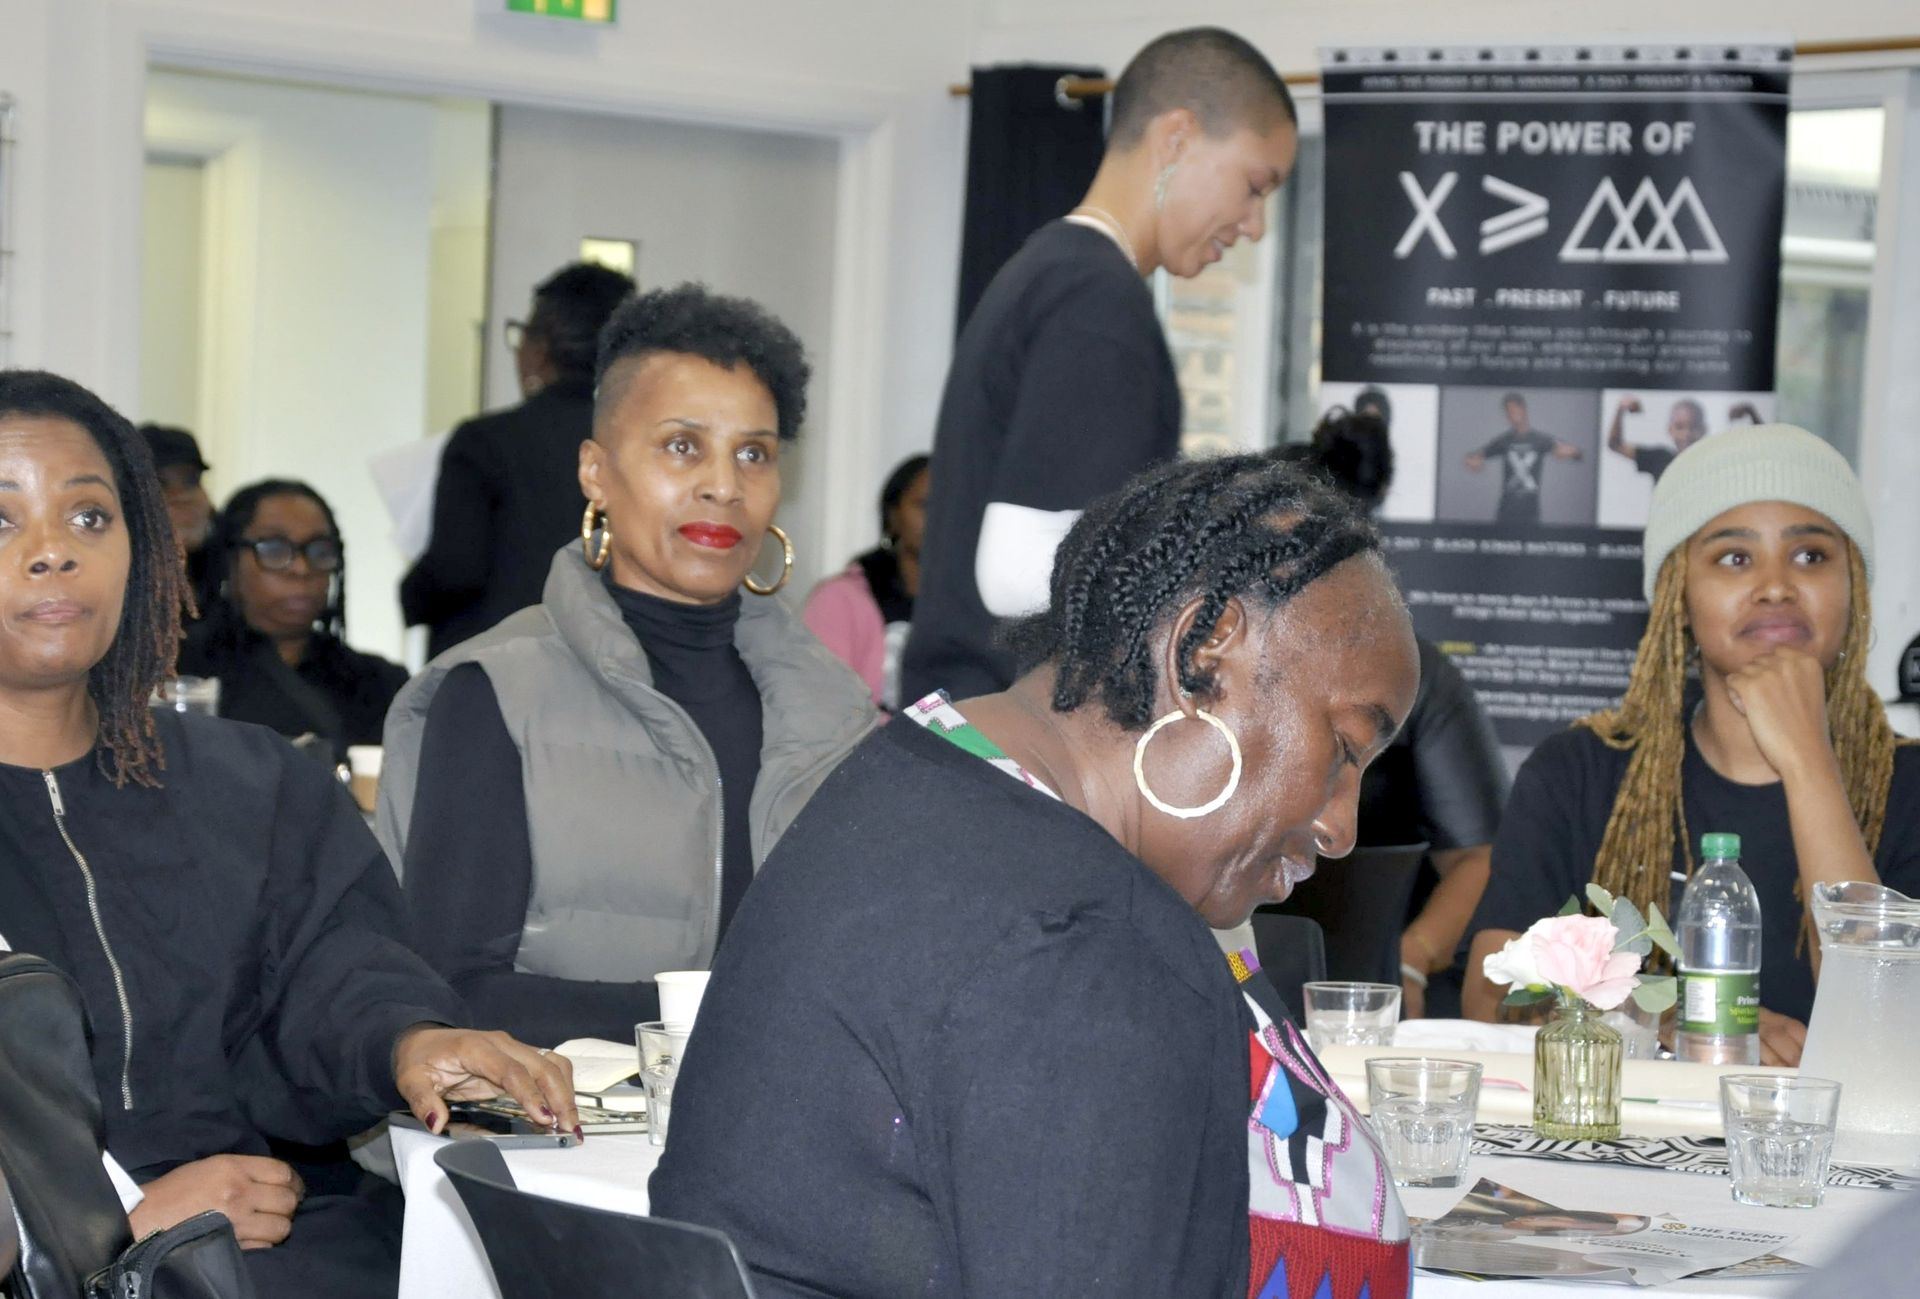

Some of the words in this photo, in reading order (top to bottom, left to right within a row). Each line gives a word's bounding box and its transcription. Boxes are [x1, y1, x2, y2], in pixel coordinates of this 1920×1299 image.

[1414, 121, 1486, 154] THE
[1497, 121, 1633, 155] POWER
[1642, 121, 1696, 154] OF
[1426, 287, 1477, 308] PAST
[1691, 1226, 1723, 1234] THE
[1729, 1230, 1789, 1240] EVENT
